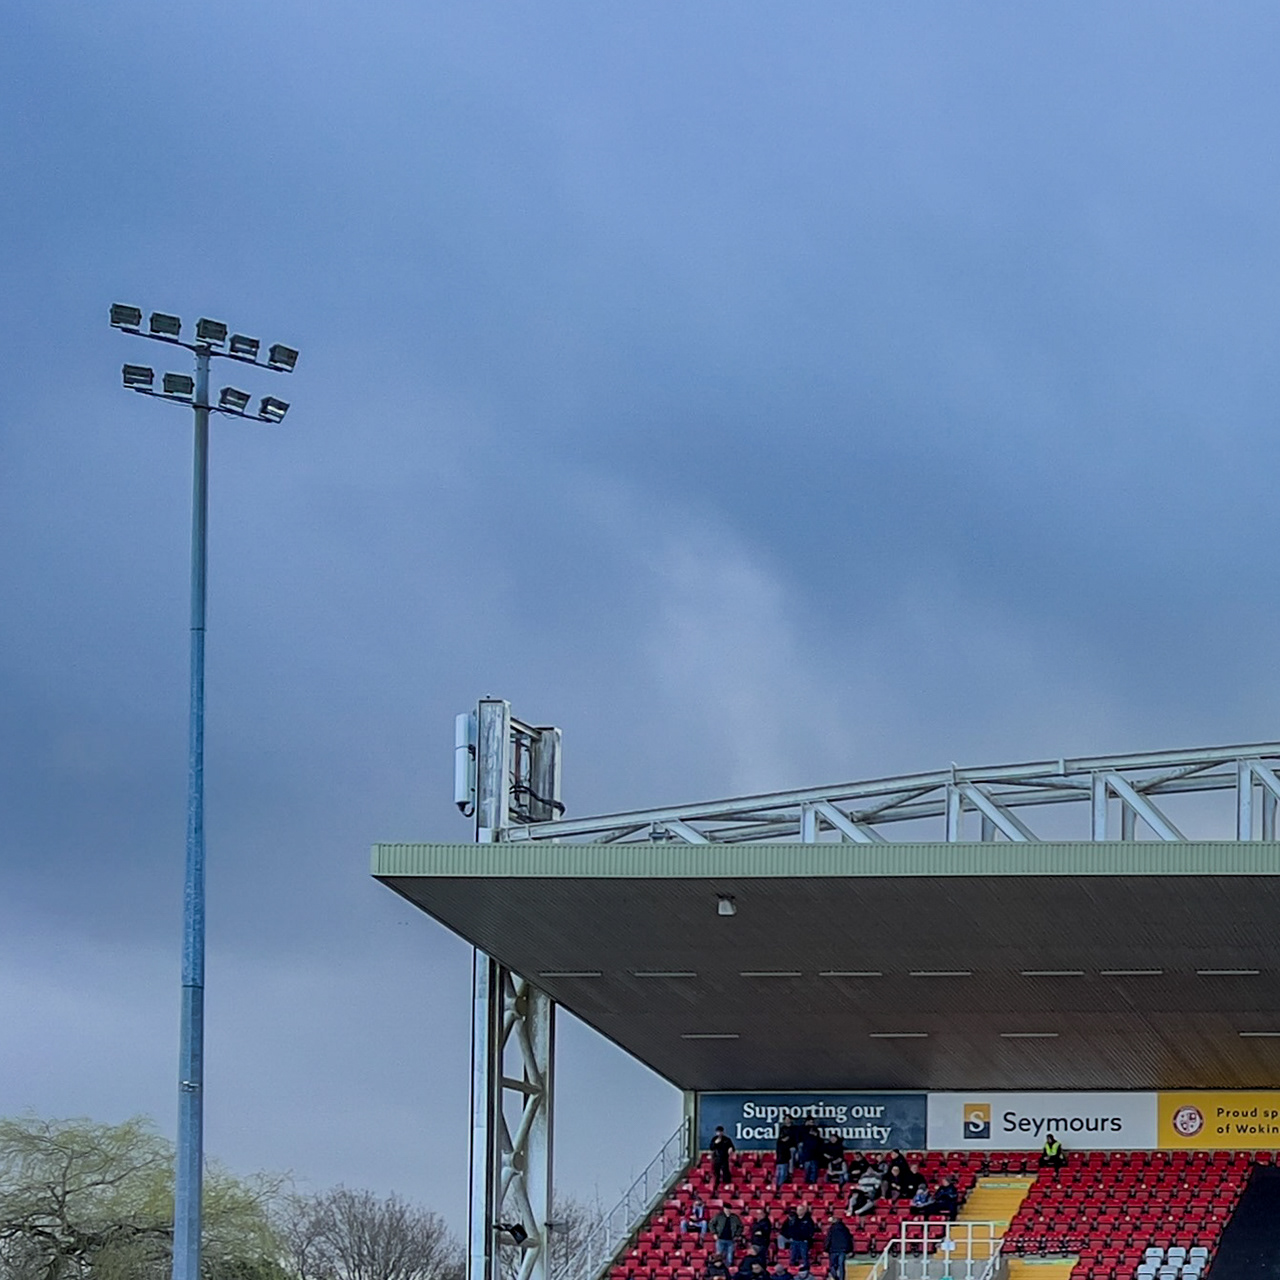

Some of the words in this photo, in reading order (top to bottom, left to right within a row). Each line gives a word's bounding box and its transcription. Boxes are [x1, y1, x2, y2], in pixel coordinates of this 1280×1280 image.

[743, 1102, 848, 1124] Supporting
[851, 1103, 885, 1119] our
[1217, 1107, 1258, 1118] Proud
[735, 1124, 779, 1140] local
[1003, 1111, 1123, 1138] Seymours
[1217, 1123, 1231, 1135] of
